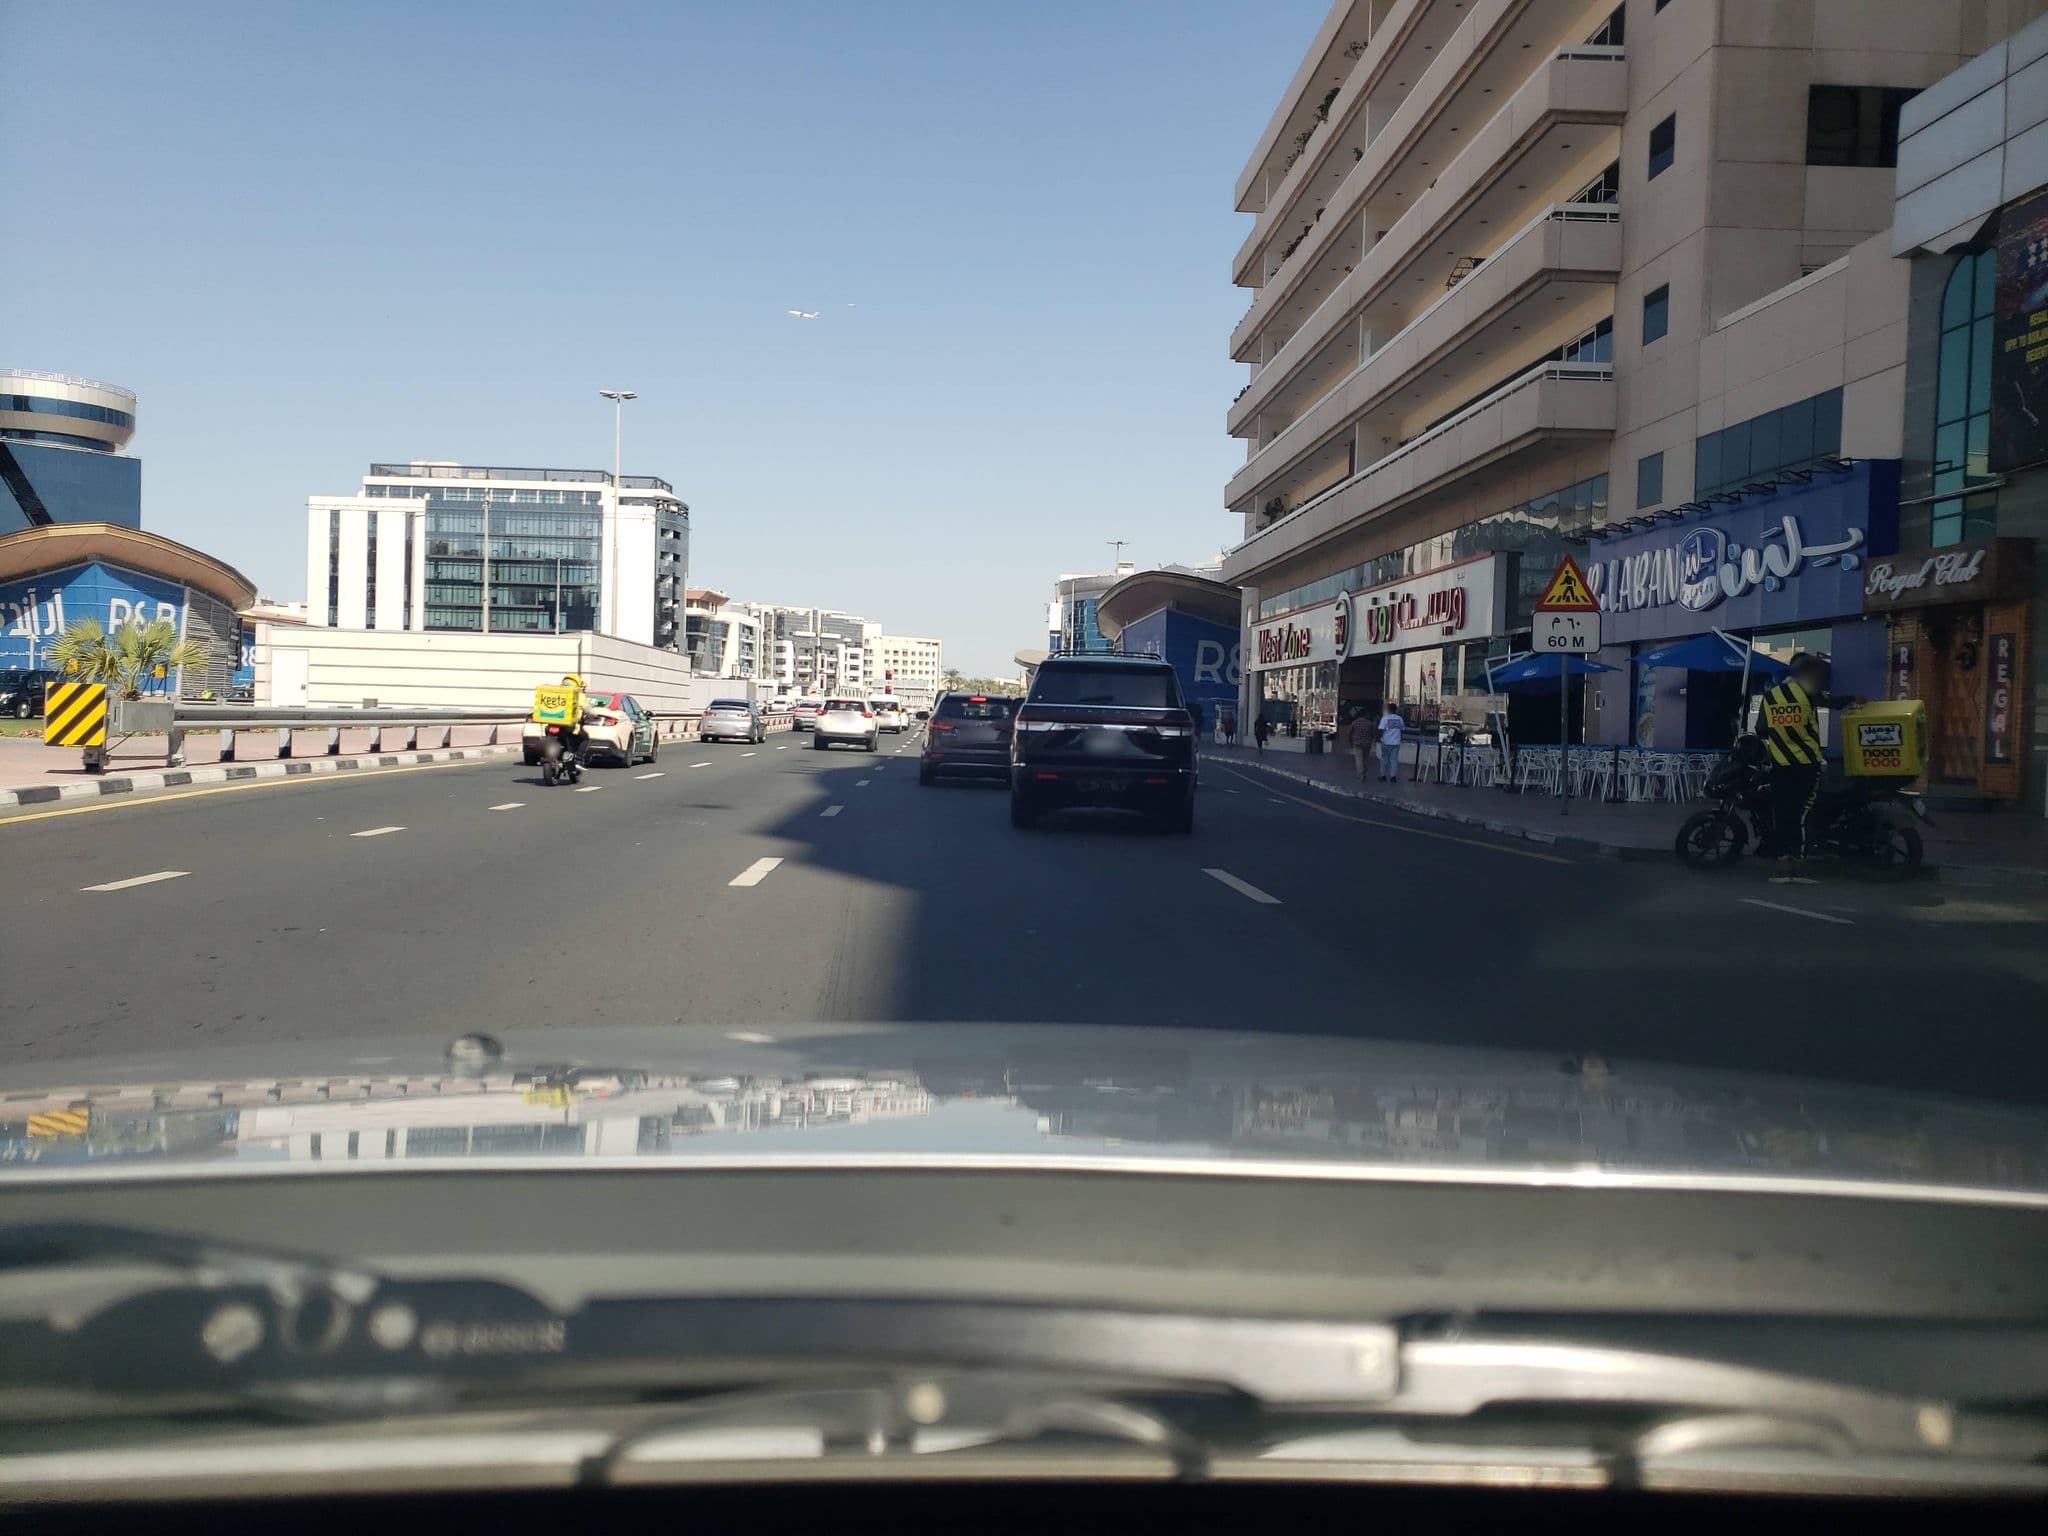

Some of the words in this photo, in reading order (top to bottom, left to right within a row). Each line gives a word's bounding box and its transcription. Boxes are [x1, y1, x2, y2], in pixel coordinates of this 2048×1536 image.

[1934, 549, 1987, 586] Club
[1367, 591, 1397, 644] زون
[1551, 617, 1561, 630] م
[1258, 628, 1282, 664] West
[1282, 622, 1312, 661] Zone
[1548, 635, 1567, 648] 60
[1573, 636, 1585, 648] M
[540, 693, 567, 707] keeta
[1992, 638, 2009, 758] REGAL
[1770, 704, 1802, 715] noon
[1771, 715, 1802, 725] FOOD
[1864, 725, 1896, 735] توصيل
[1862, 748, 1901, 757] noon
[1863, 758, 1901, 768] FOOD
